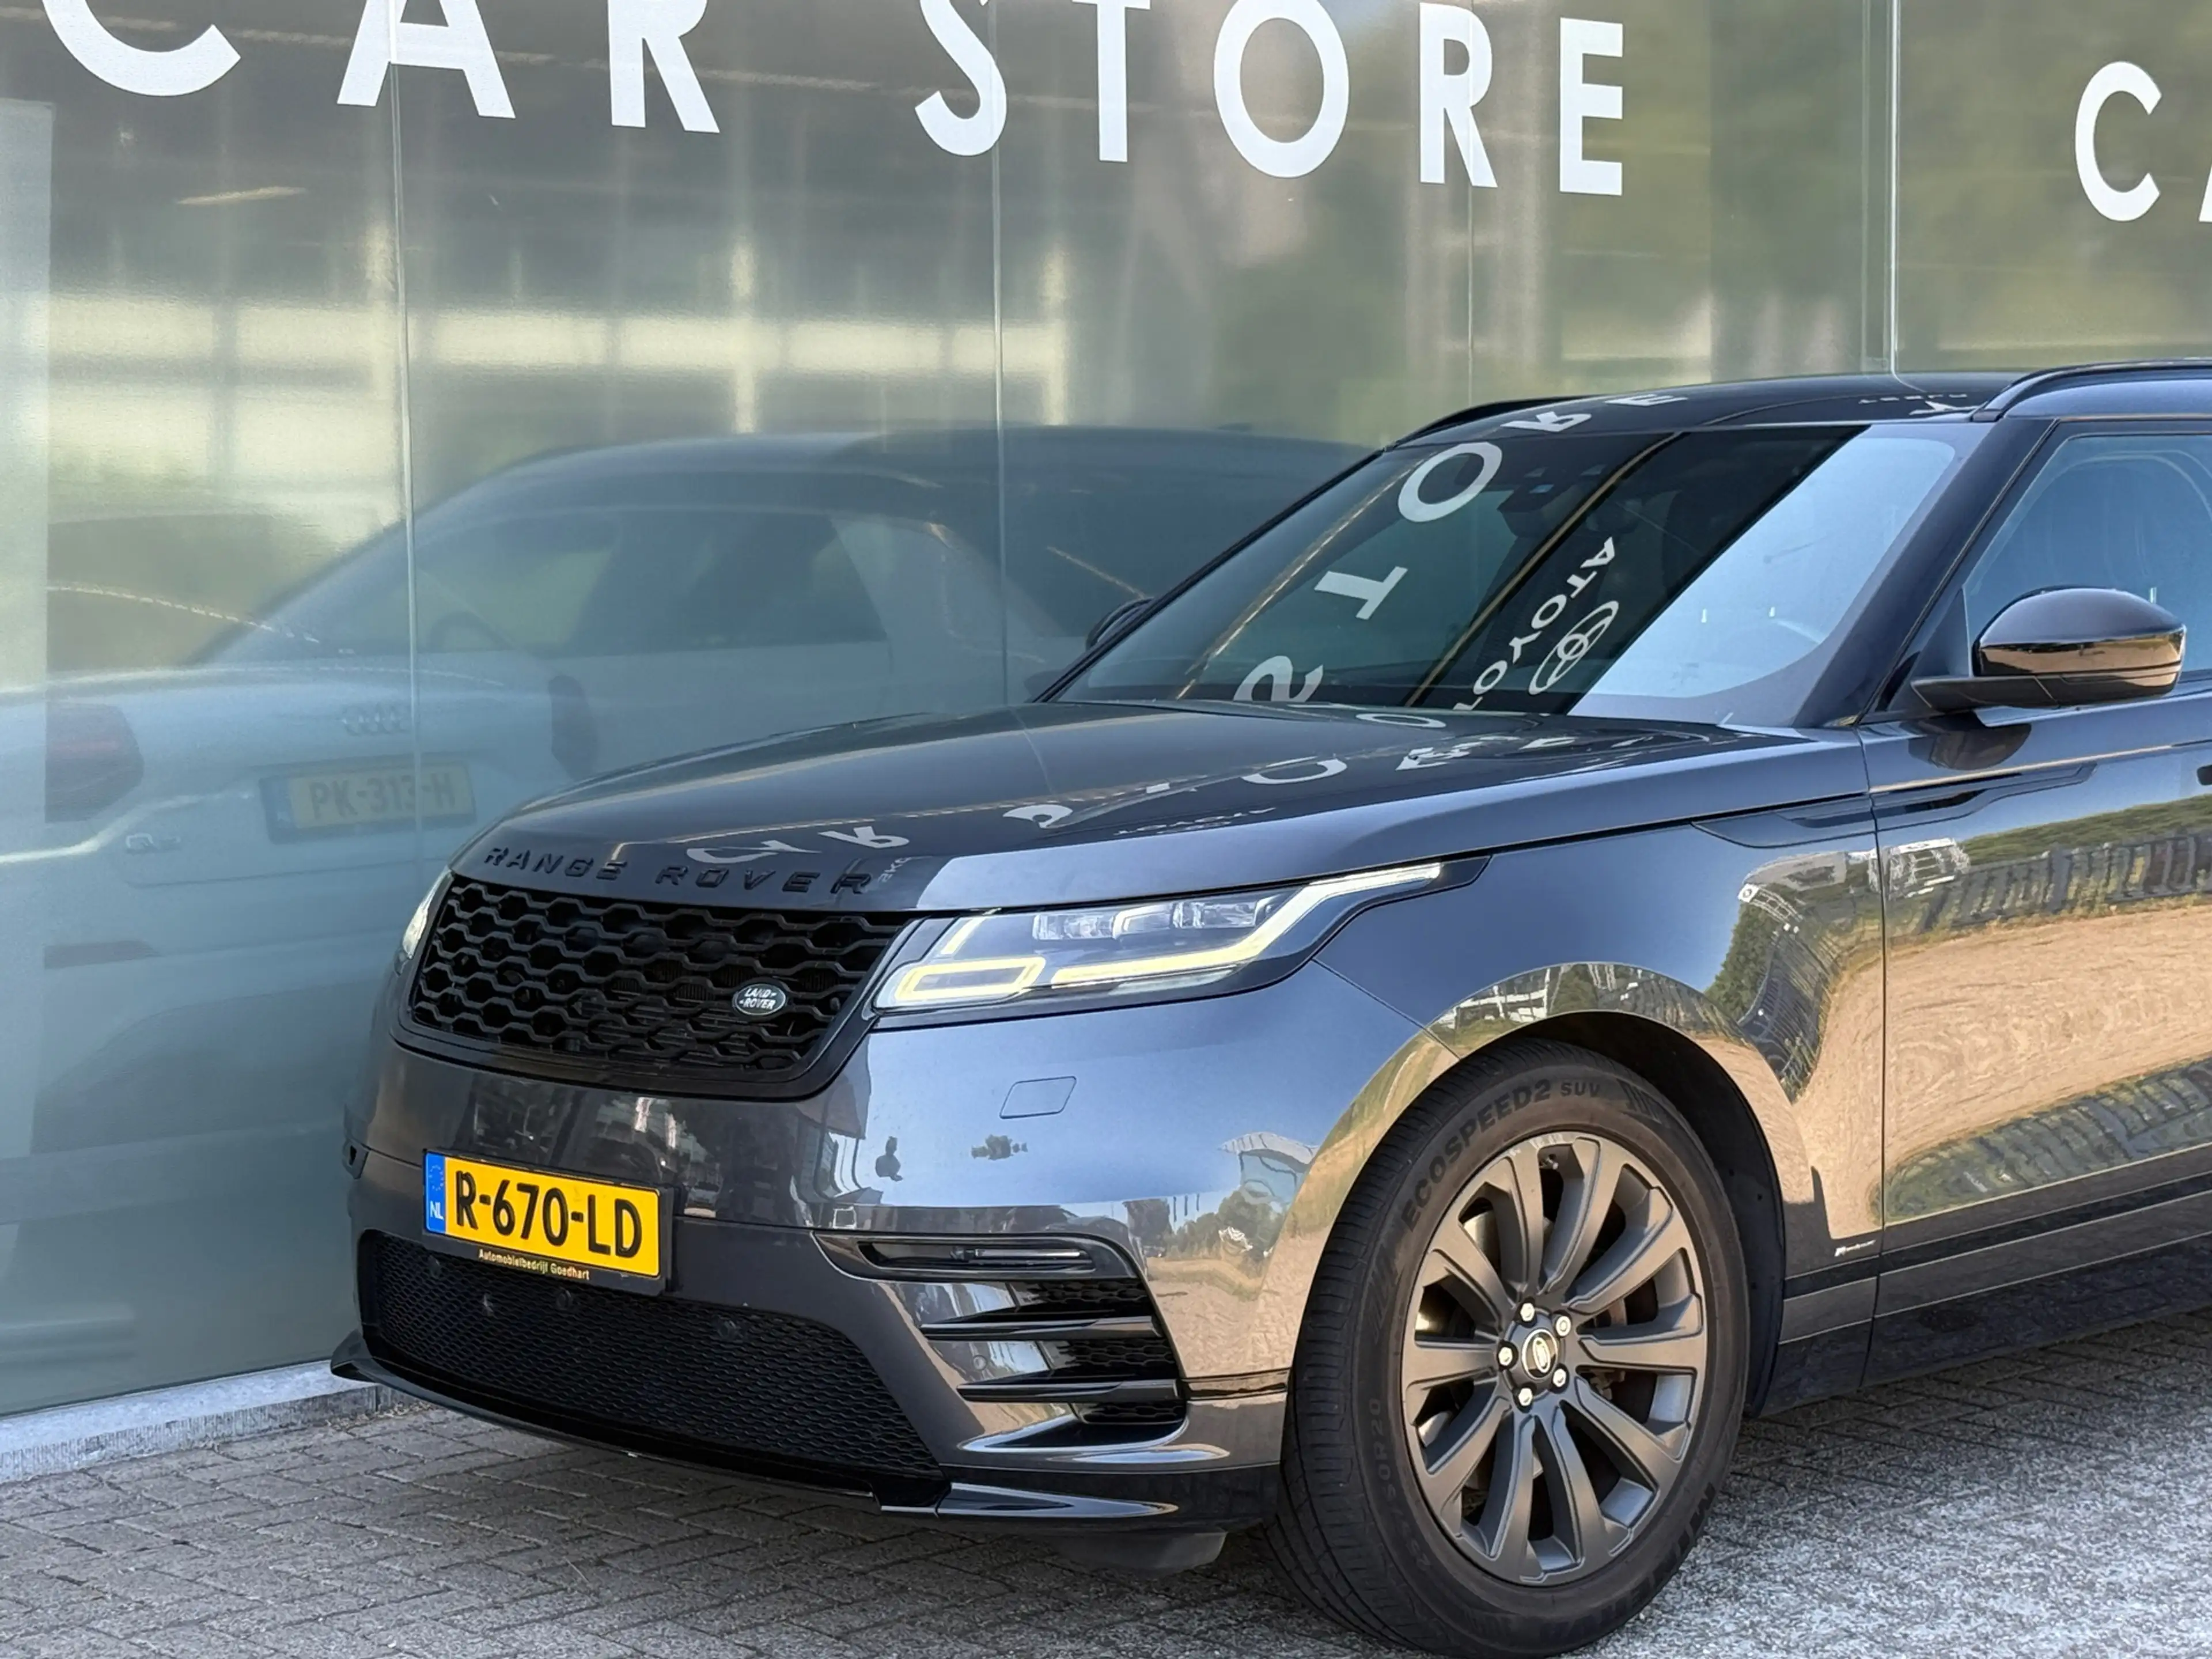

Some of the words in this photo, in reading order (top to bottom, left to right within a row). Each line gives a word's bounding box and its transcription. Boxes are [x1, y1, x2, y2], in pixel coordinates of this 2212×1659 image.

[914, 0, 1623, 196] STORE
[2075, 60, 2212, 222] C
[484, 847, 628, 880] RANGE
[654, 865, 872, 895] ROVER
[1400, 1078, 1551, 1233] ECOSPEED2
[1560, 1081, 1600, 1097] SUV
[430, 1200, 444, 1221] NL
[455, 1170, 642, 1259] R-670-LD
[479, 1248, 548, 1275] Automobielbedrijf
[550, 1263, 590, 1281] Goedhart
